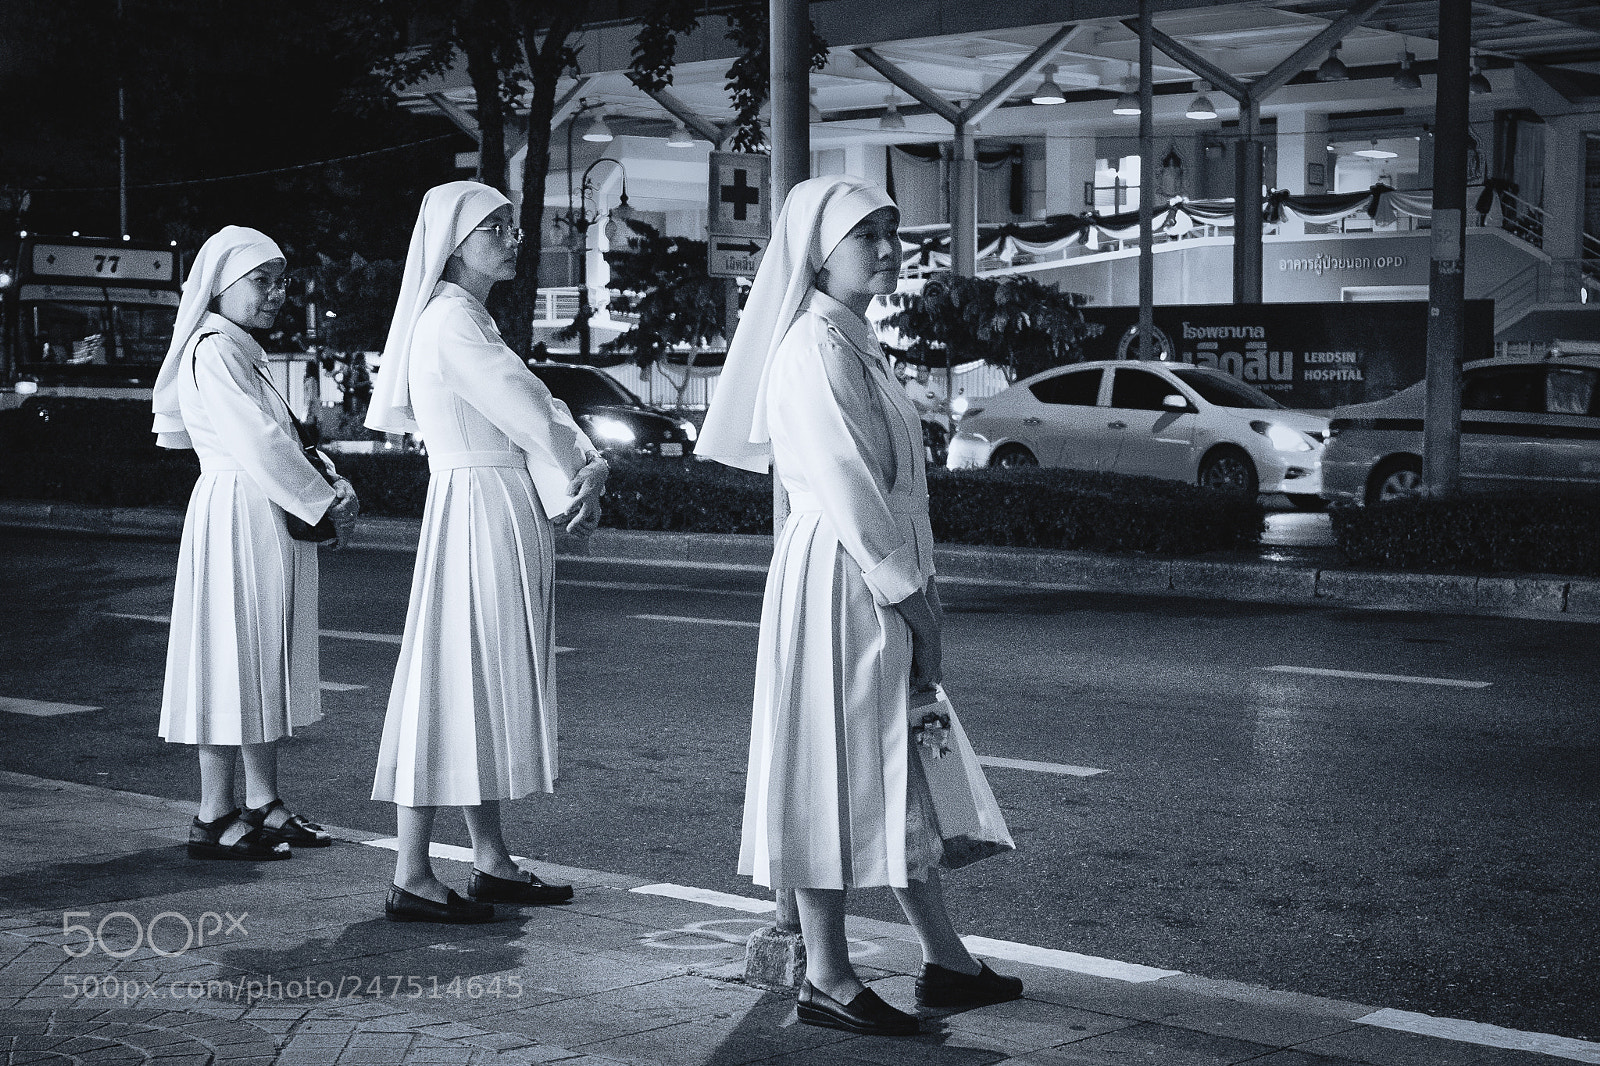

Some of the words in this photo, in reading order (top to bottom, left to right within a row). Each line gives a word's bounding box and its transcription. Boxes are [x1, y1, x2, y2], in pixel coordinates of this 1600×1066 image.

[94, 254, 121, 273] 77
[1279, 252, 1371, 276] อาคารผู้ป่วยนอก
[1373, 255, 1407, 269] (OPD)
[1182, 321, 1266, 340] โรงพยาบาล
[1303, 351, 1357, 364] LERDSIN
[1303, 369, 1364, 382] HOSPITAL
